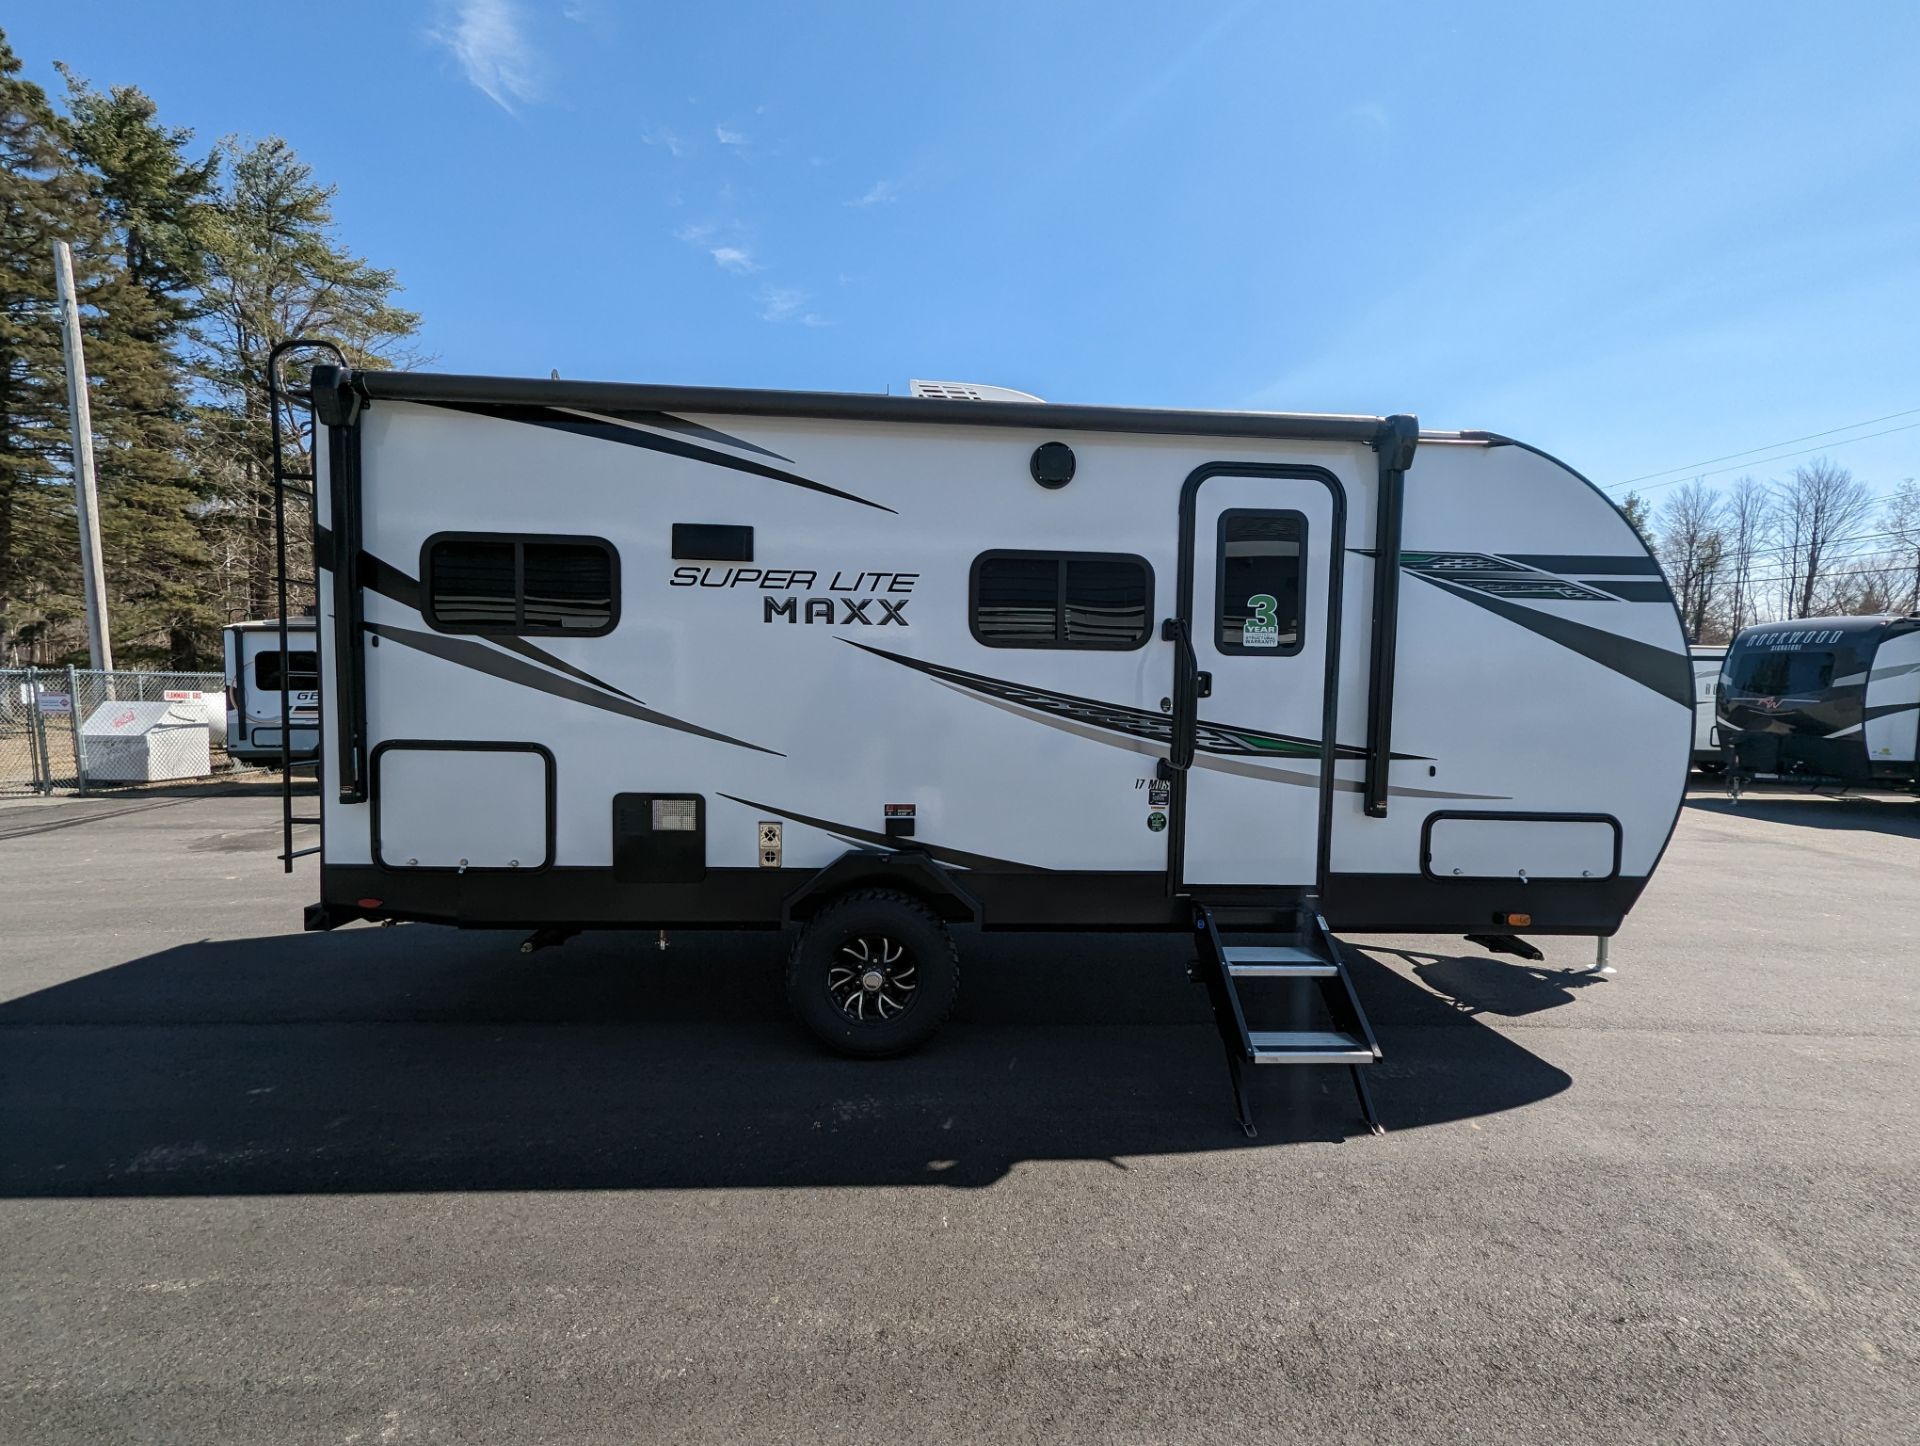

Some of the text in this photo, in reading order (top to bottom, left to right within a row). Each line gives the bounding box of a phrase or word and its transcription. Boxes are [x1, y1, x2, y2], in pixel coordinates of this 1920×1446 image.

[669, 566, 921, 593] SUPER LITE
[763, 595, 910, 627] MAXX
[1246, 593, 1278, 627] 3
[1746, 630, 1844, 647] ROCKWOOD
[165, 691, 191, 699] FLAMMABLE
[1135, 779, 1146, 790] 17
